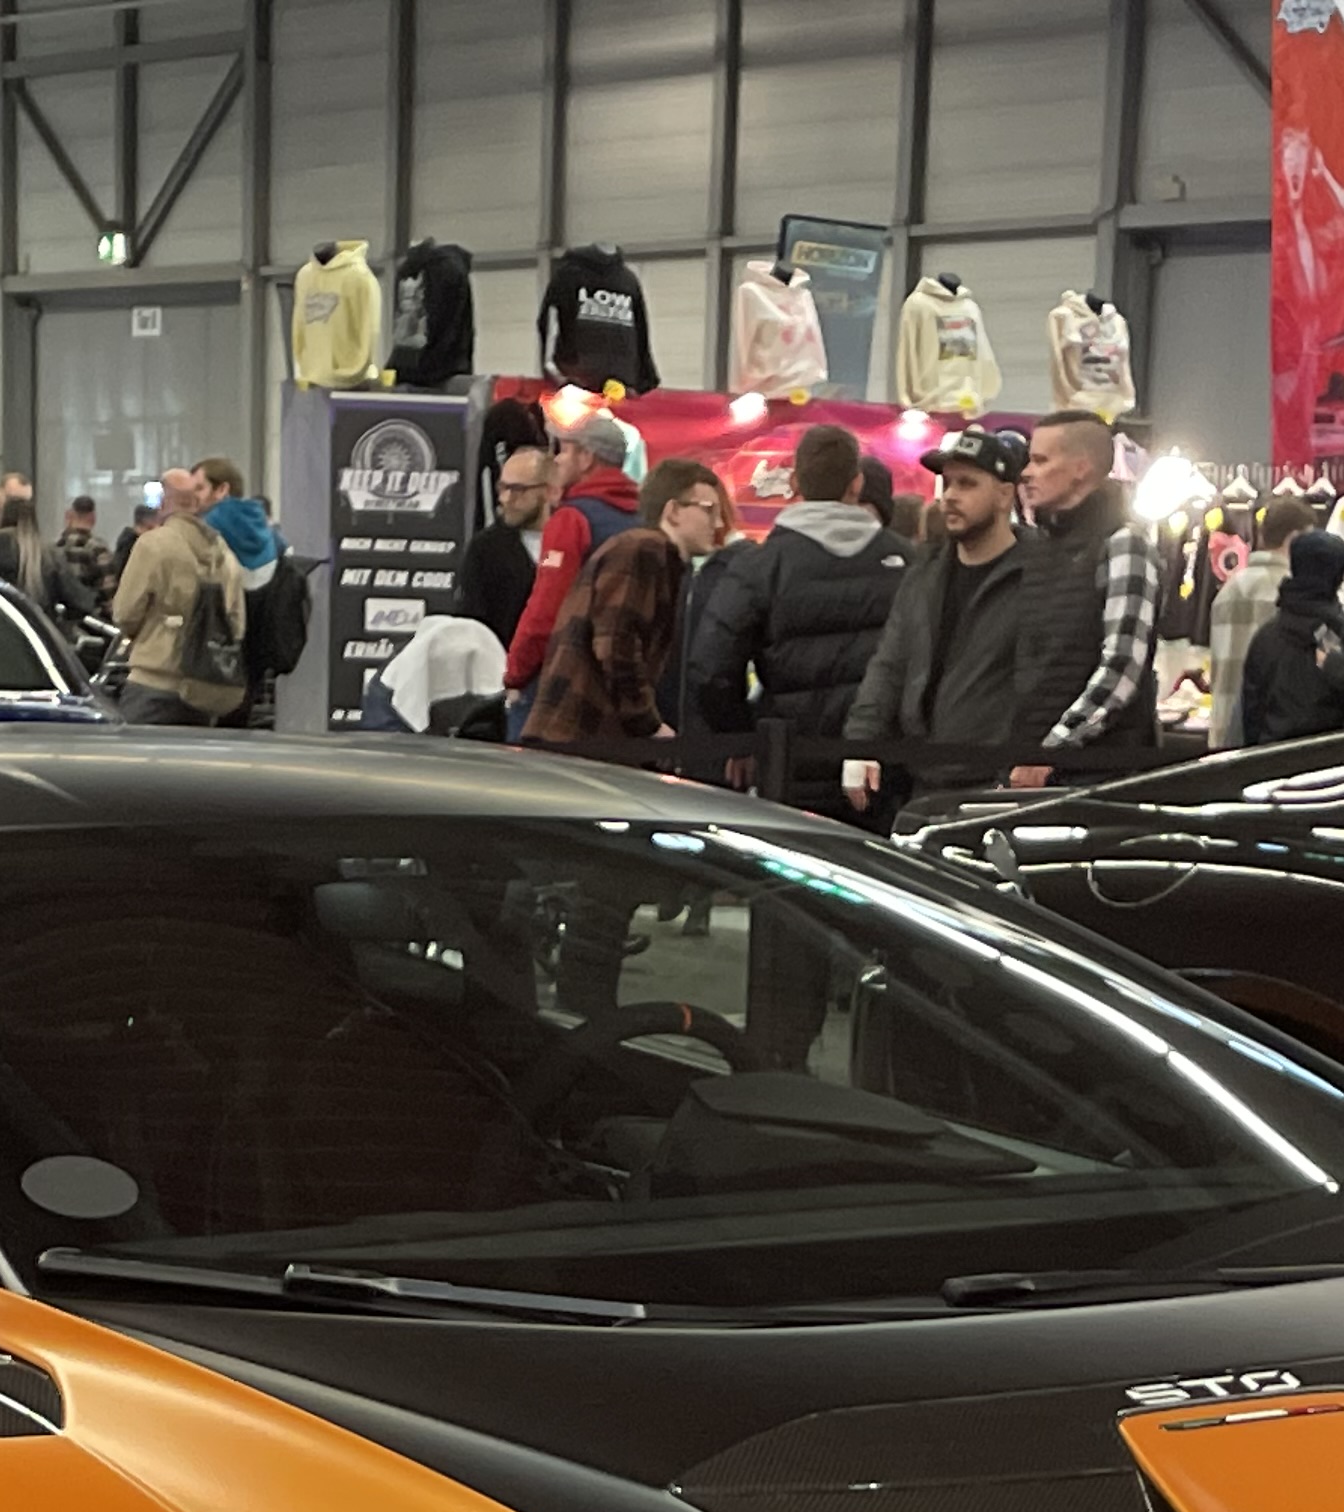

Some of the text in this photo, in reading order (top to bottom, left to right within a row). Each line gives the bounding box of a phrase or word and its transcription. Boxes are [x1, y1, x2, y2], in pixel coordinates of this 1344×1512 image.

[578, 286, 632, 308] LOW
[340, 567, 455, 588] MIT DEM CODE
[1125, 1369, 1302, 1405] STO
